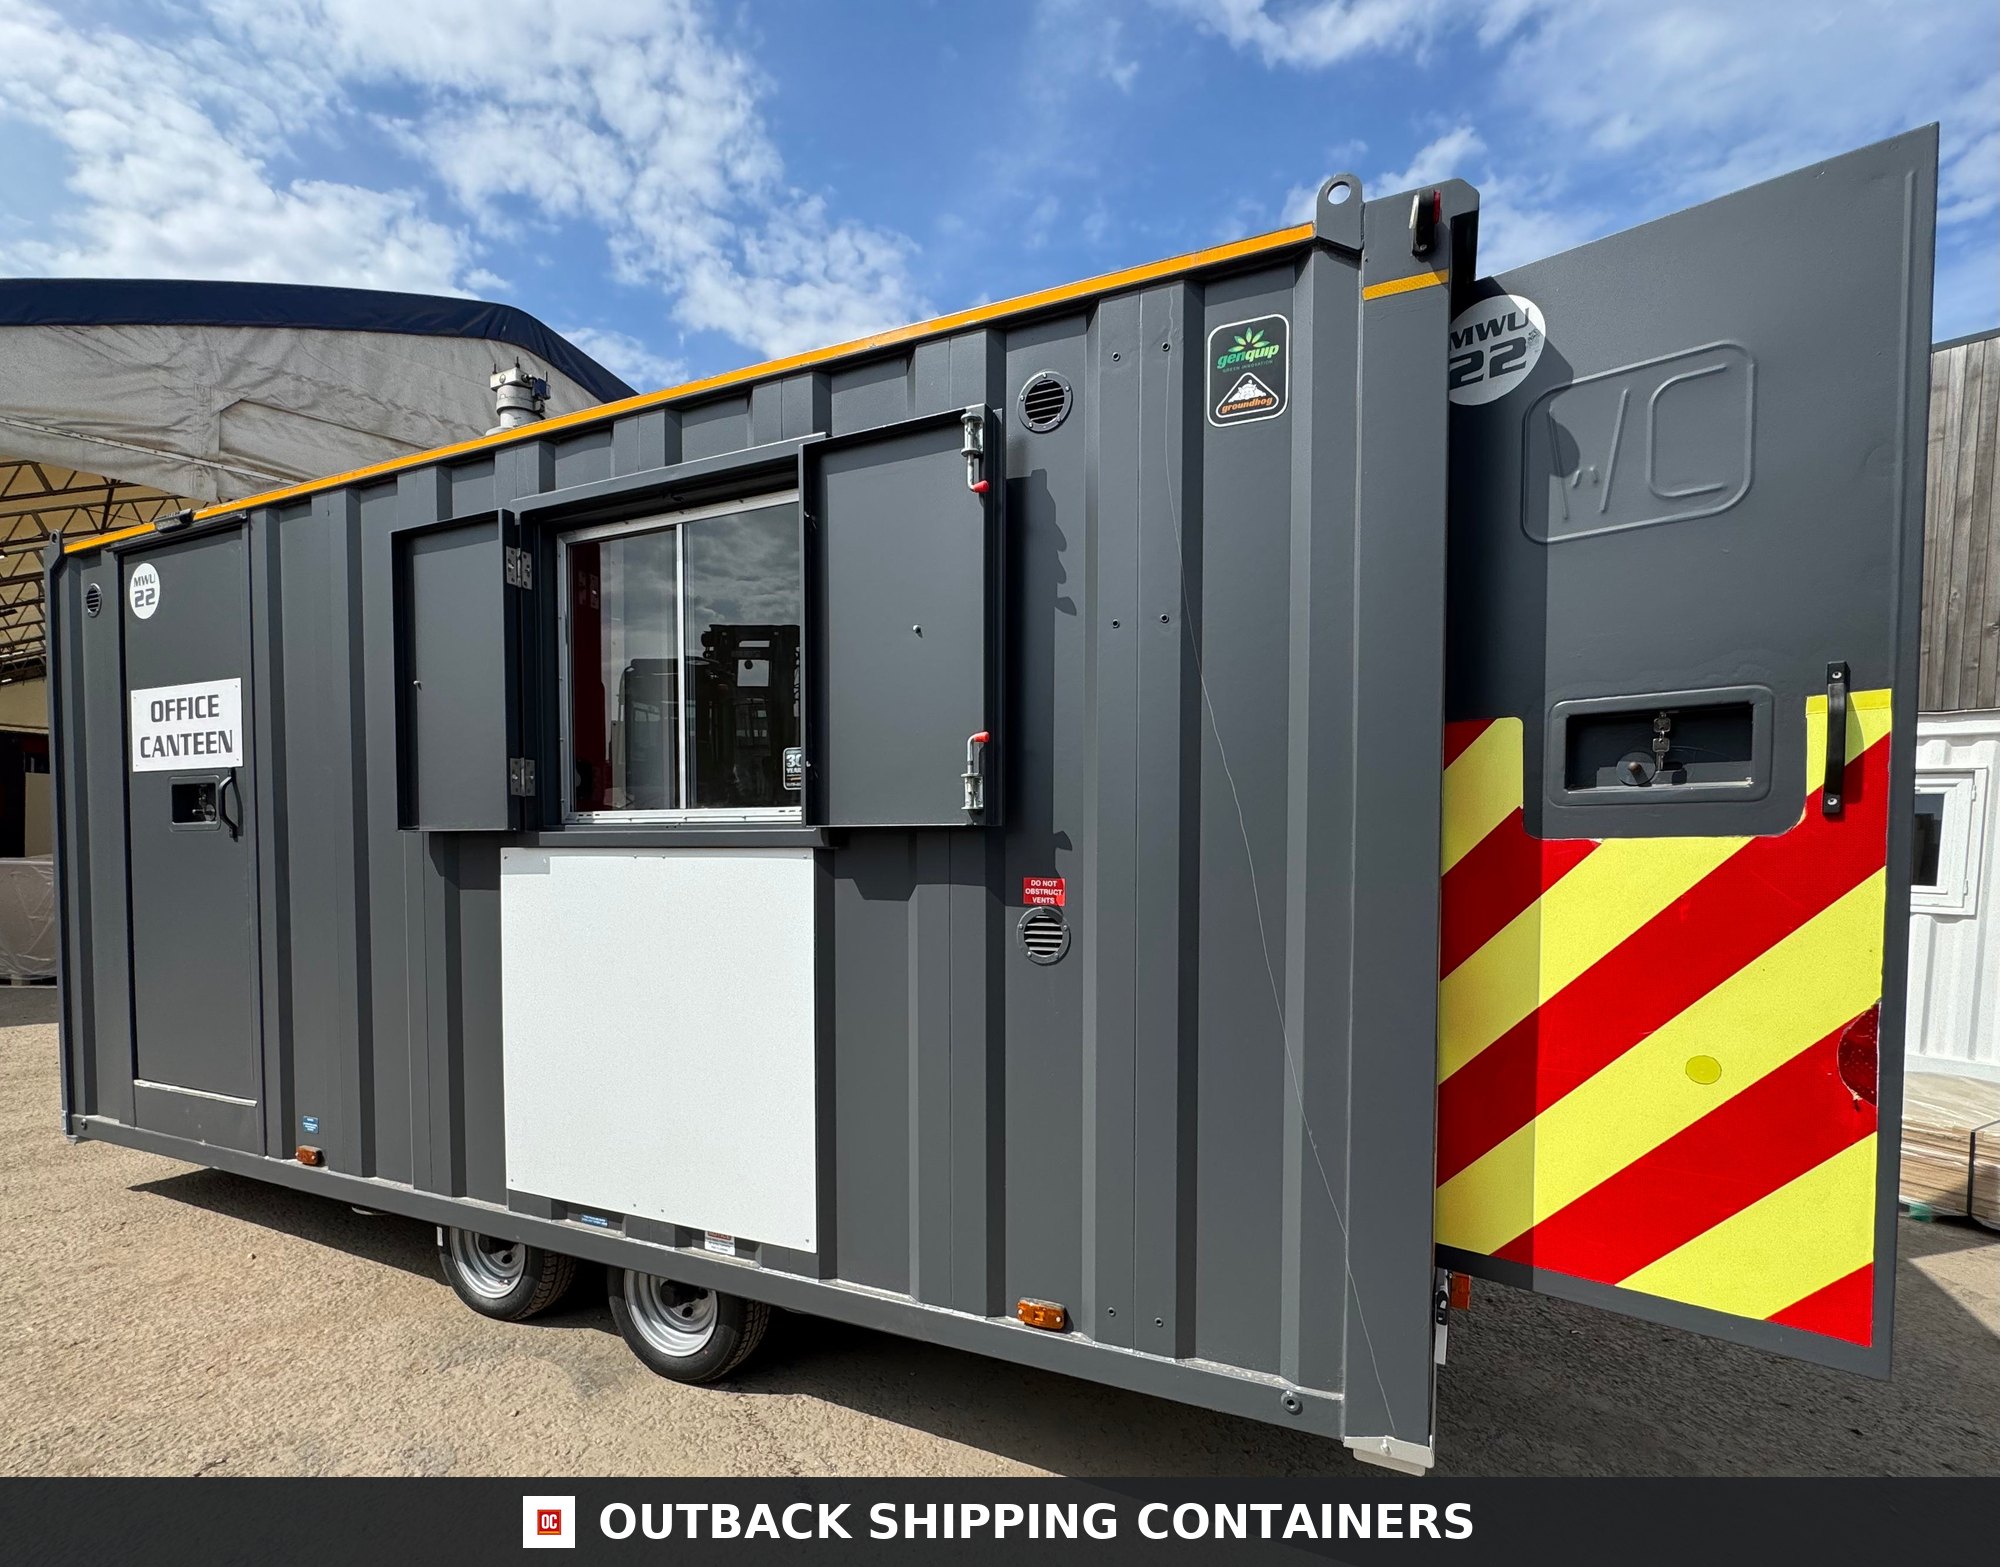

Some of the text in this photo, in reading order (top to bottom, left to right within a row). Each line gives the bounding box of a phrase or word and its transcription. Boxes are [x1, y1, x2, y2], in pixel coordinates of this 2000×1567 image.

[1449, 307, 1530, 350] MWU
[1216, 344, 1280, 369] genquip
[1449, 336, 1527, 390] 22
[1221, 396, 1273, 413] groundhog
[133, 573, 156, 587] MWU
[134, 588, 156, 608] 22
[151, 694, 220, 723] OFFICE
[140, 729, 233, 759] CANTEEN
[1025, 888, 1063, 896] OBSTRUCT
[1032, 896, 1055, 904] VENTS
